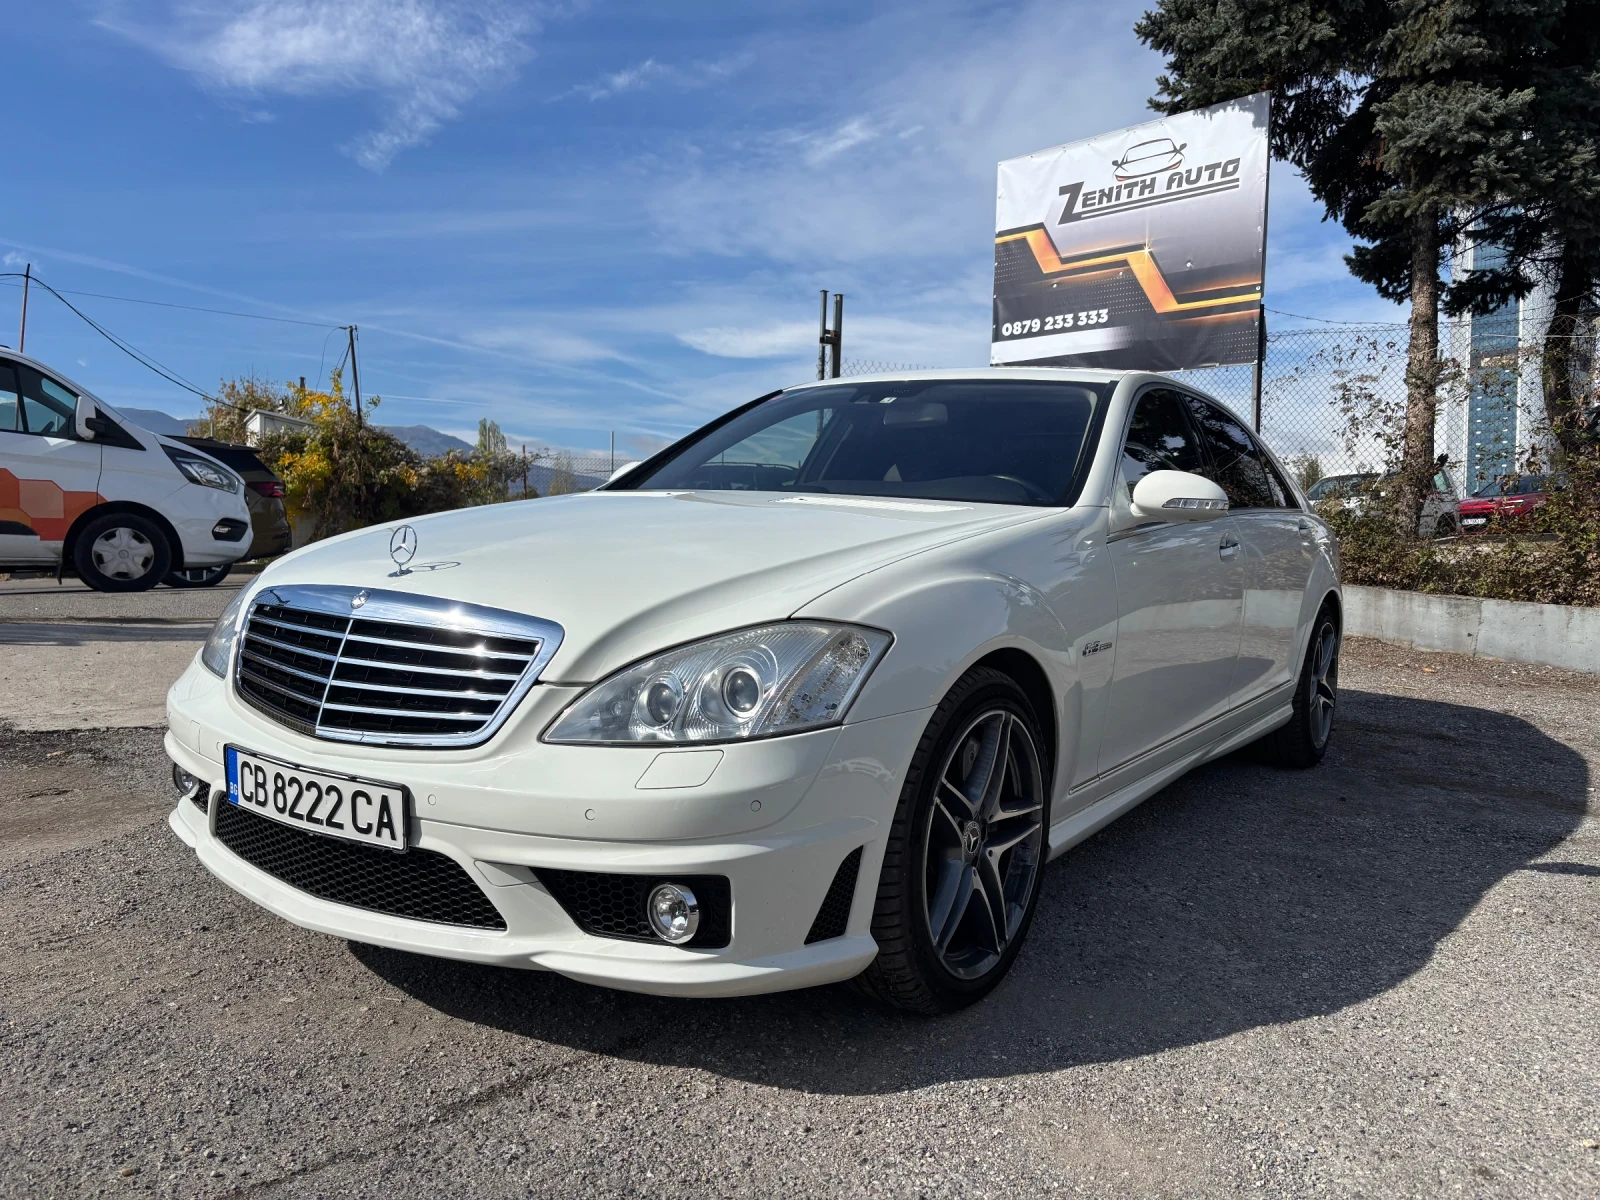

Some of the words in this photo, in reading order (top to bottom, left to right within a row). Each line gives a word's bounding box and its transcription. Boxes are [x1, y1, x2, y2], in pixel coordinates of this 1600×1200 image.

[1057, 177, 1157, 226] ZENITH
[1165, 157, 1241, 191] AUTO
[1001, 318, 1041, 336] 0879
[1043, 313, 1074, 331] 233
[1077, 307, 1109, 326] 333
[229, 781, 238, 796] BG
[240, 760, 268, 808] CB
[273, 771, 345, 830] 8222
[350, 789, 397, 841] CA
